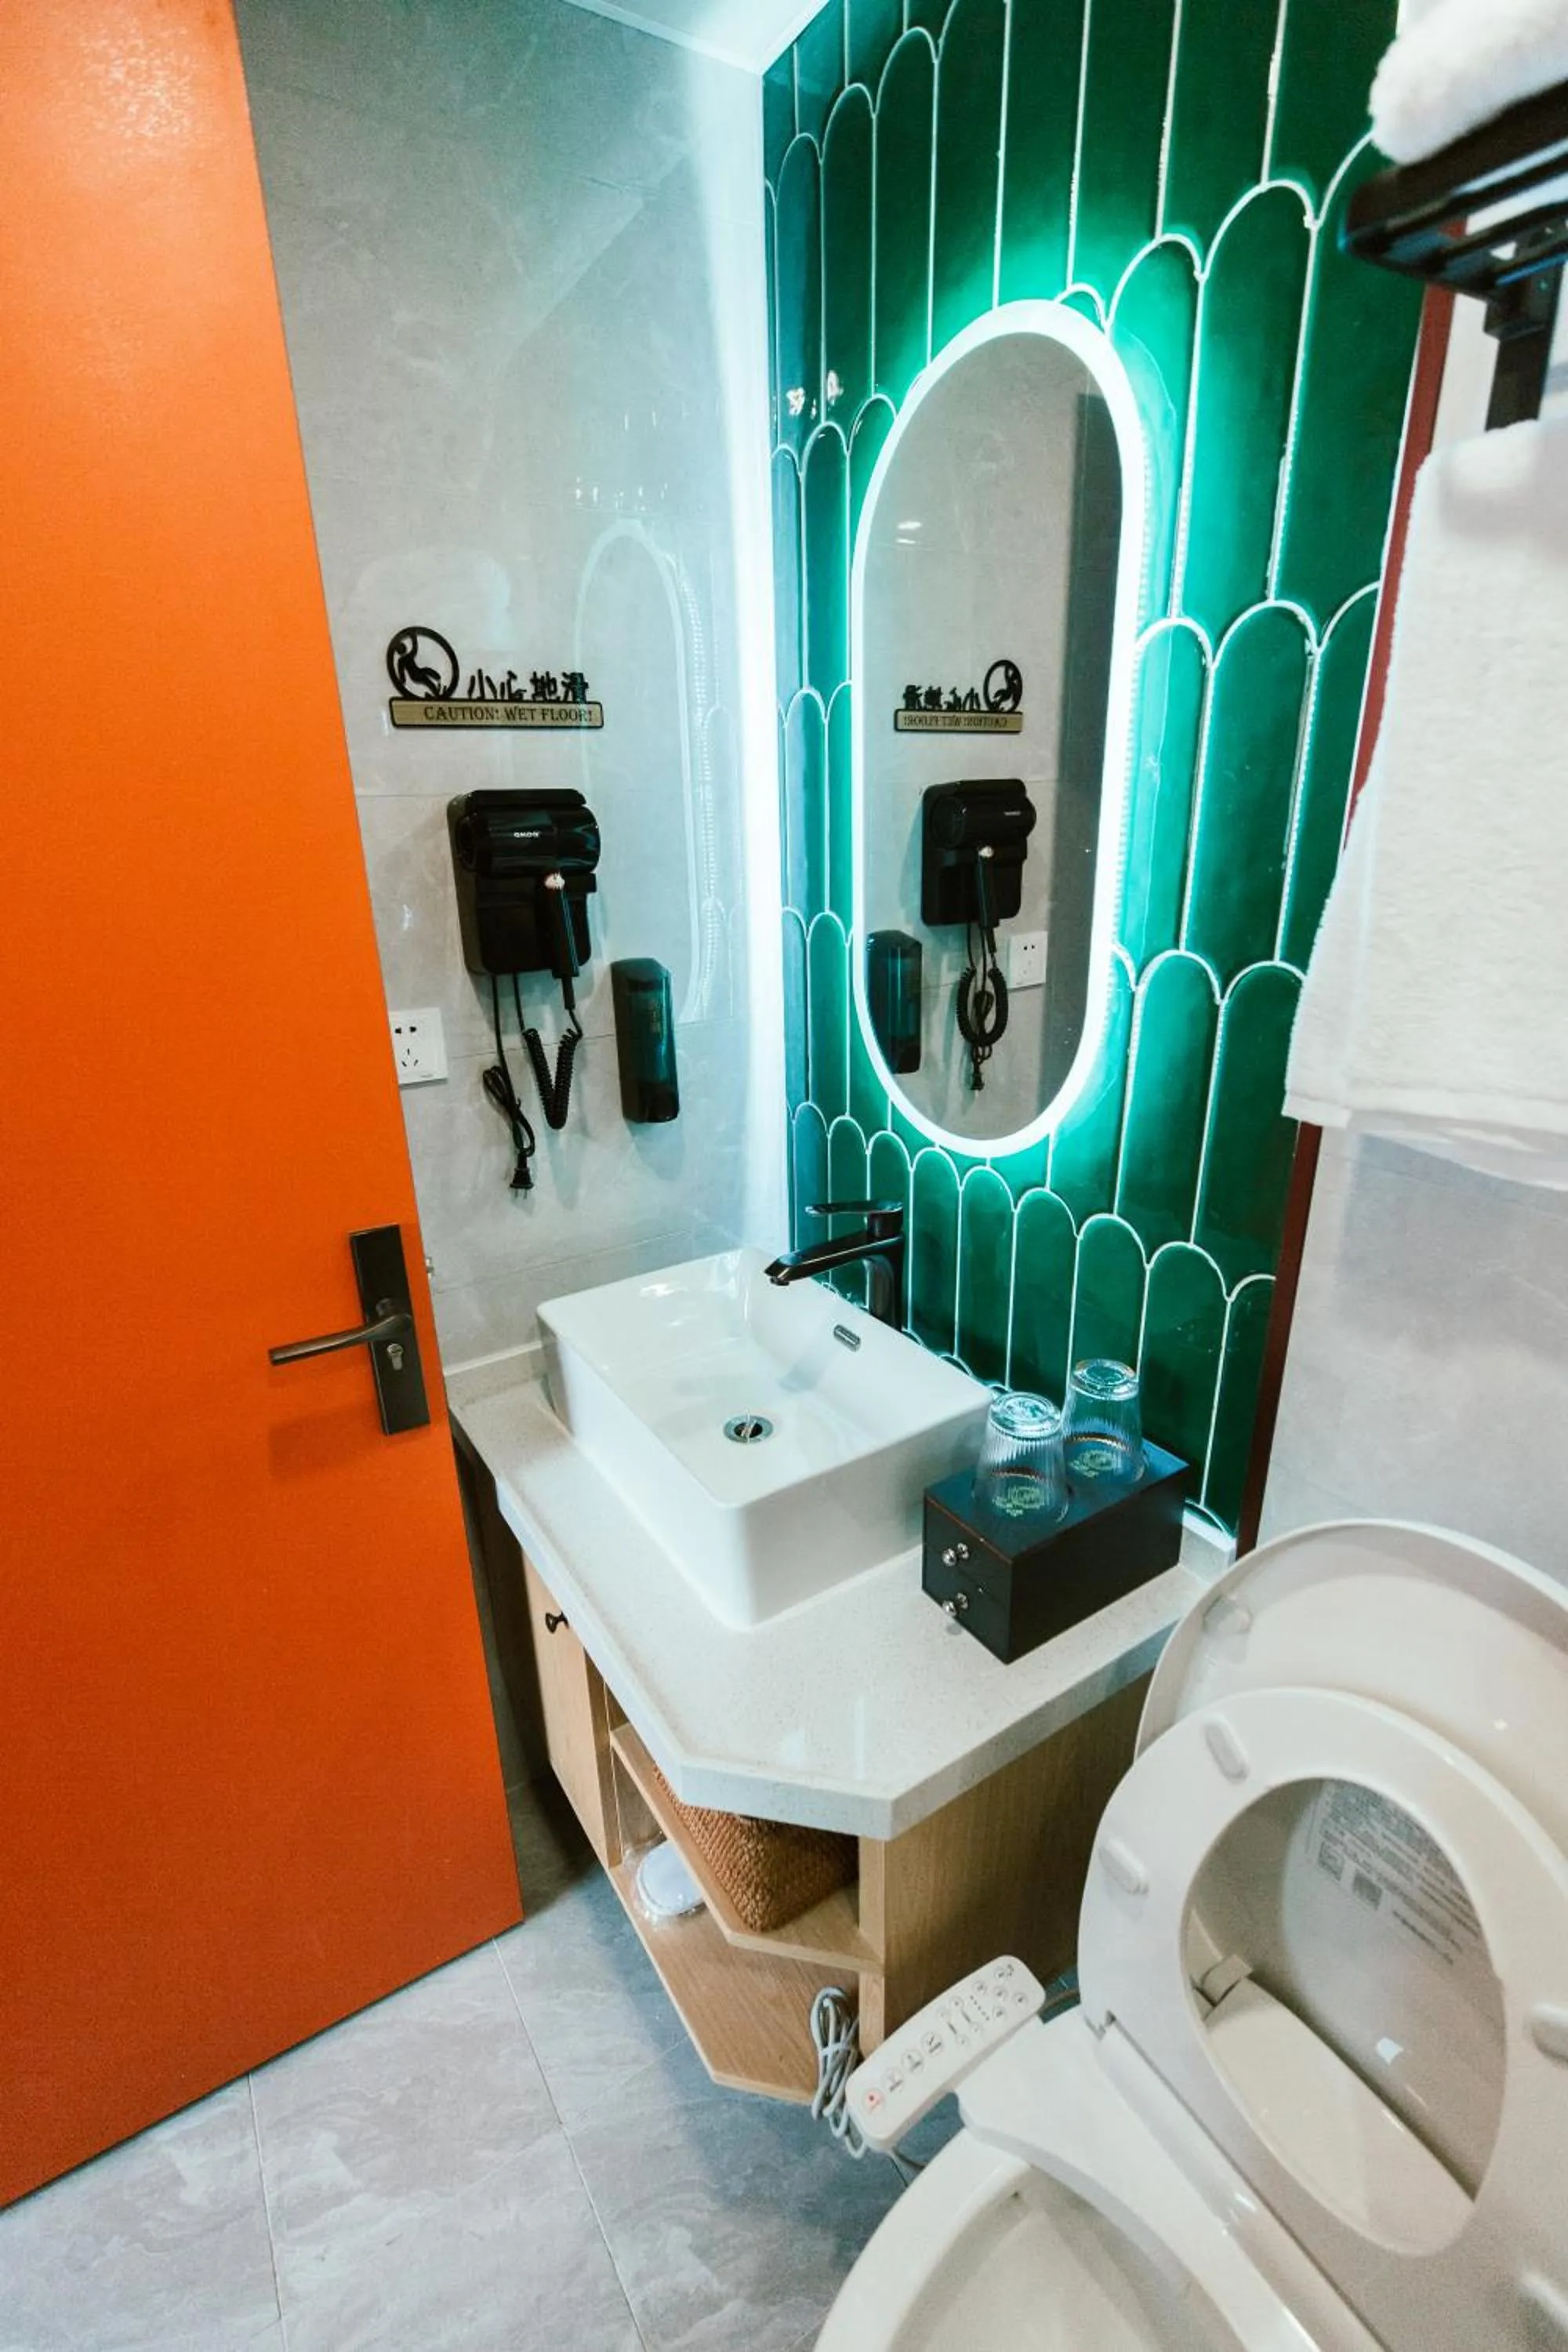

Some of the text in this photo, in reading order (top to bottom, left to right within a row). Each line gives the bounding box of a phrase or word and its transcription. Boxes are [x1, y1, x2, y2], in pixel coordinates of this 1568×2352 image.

[467, 668, 590, 702] 小心地滑
[504, 706, 537, 721] WET
[541, 707, 593, 722] FLOOR!
